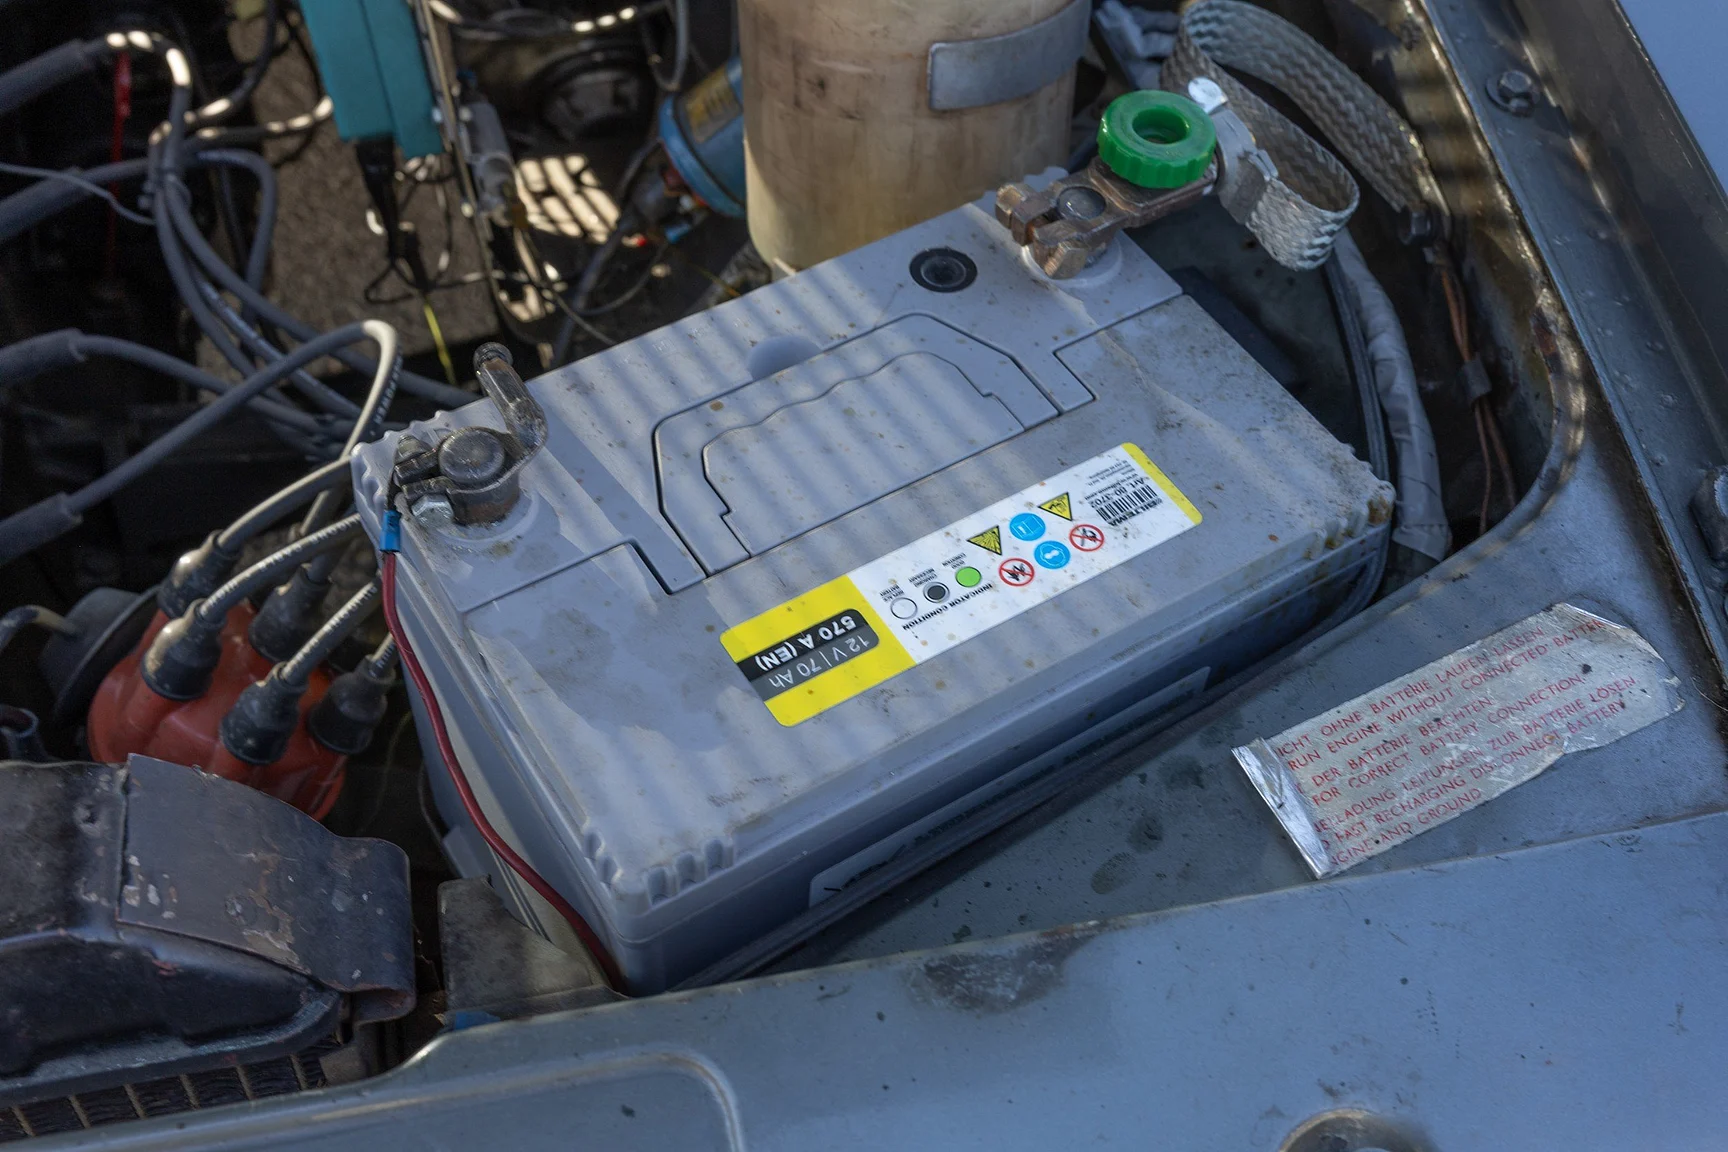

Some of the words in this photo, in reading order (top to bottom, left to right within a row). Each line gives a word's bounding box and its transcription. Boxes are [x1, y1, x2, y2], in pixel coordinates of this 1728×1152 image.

[947, 582, 992, 608] INDICATOR
[816, 613, 856, 642] 570
[900, 603, 948, 632] CONDITION
[753, 640, 798, 672] (EN)
[797, 632, 812, 650] A
[831, 644, 847, 662] V
[843, 634, 869, 653] 12
[767, 667, 792, 689] Ah
[794, 656, 821, 678] 70
[1318, 710, 1364, 736] OHNE
[1369, 677, 1433, 713] BATTERIE
[1435, 651, 1489, 683] LAUFEN
[1493, 626, 1545, 656] LASSEN
[1287, 749, 1321, 771] RUN
[1326, 721, 1384, 753] ENGINE
[1386, 687, 1455, 725] WITHOUT
[1459, 643, 1549, 690] CONNECTED
[1551, 617, 1605, 647] BATTER
[1311, 786, 1342, 806] FOR
[1346, 752, 1412, 789] CORRECT
[1419, 721, 1480, 756] BATTERY
[1485, 672, 1584, 724] CONNECTION
[1311, 766, 1342, 787] DER
[1346, 733, 1412, 769] BATTERIE
[1418, 695, 1492, 736] BEACHTEN
[1400, 746, 1484, 791] LEITUNGEN
[1486, 729, 1519, 751] ZUR
[1521, 697, 1586, 735] BATTERIE
[1587, 673, 1636, 702] LÖSEN
[1334, 819, 1368, 843] FAST
[1373, 773, 1467, 824] RECHARGING
[1566, 698, 1626, 733] BATTERY
[1327, 835, 1377, 865] NGINE
[1378, 817, 1413, 843] AND
[1415, 786, 1482, 824] GROUND
